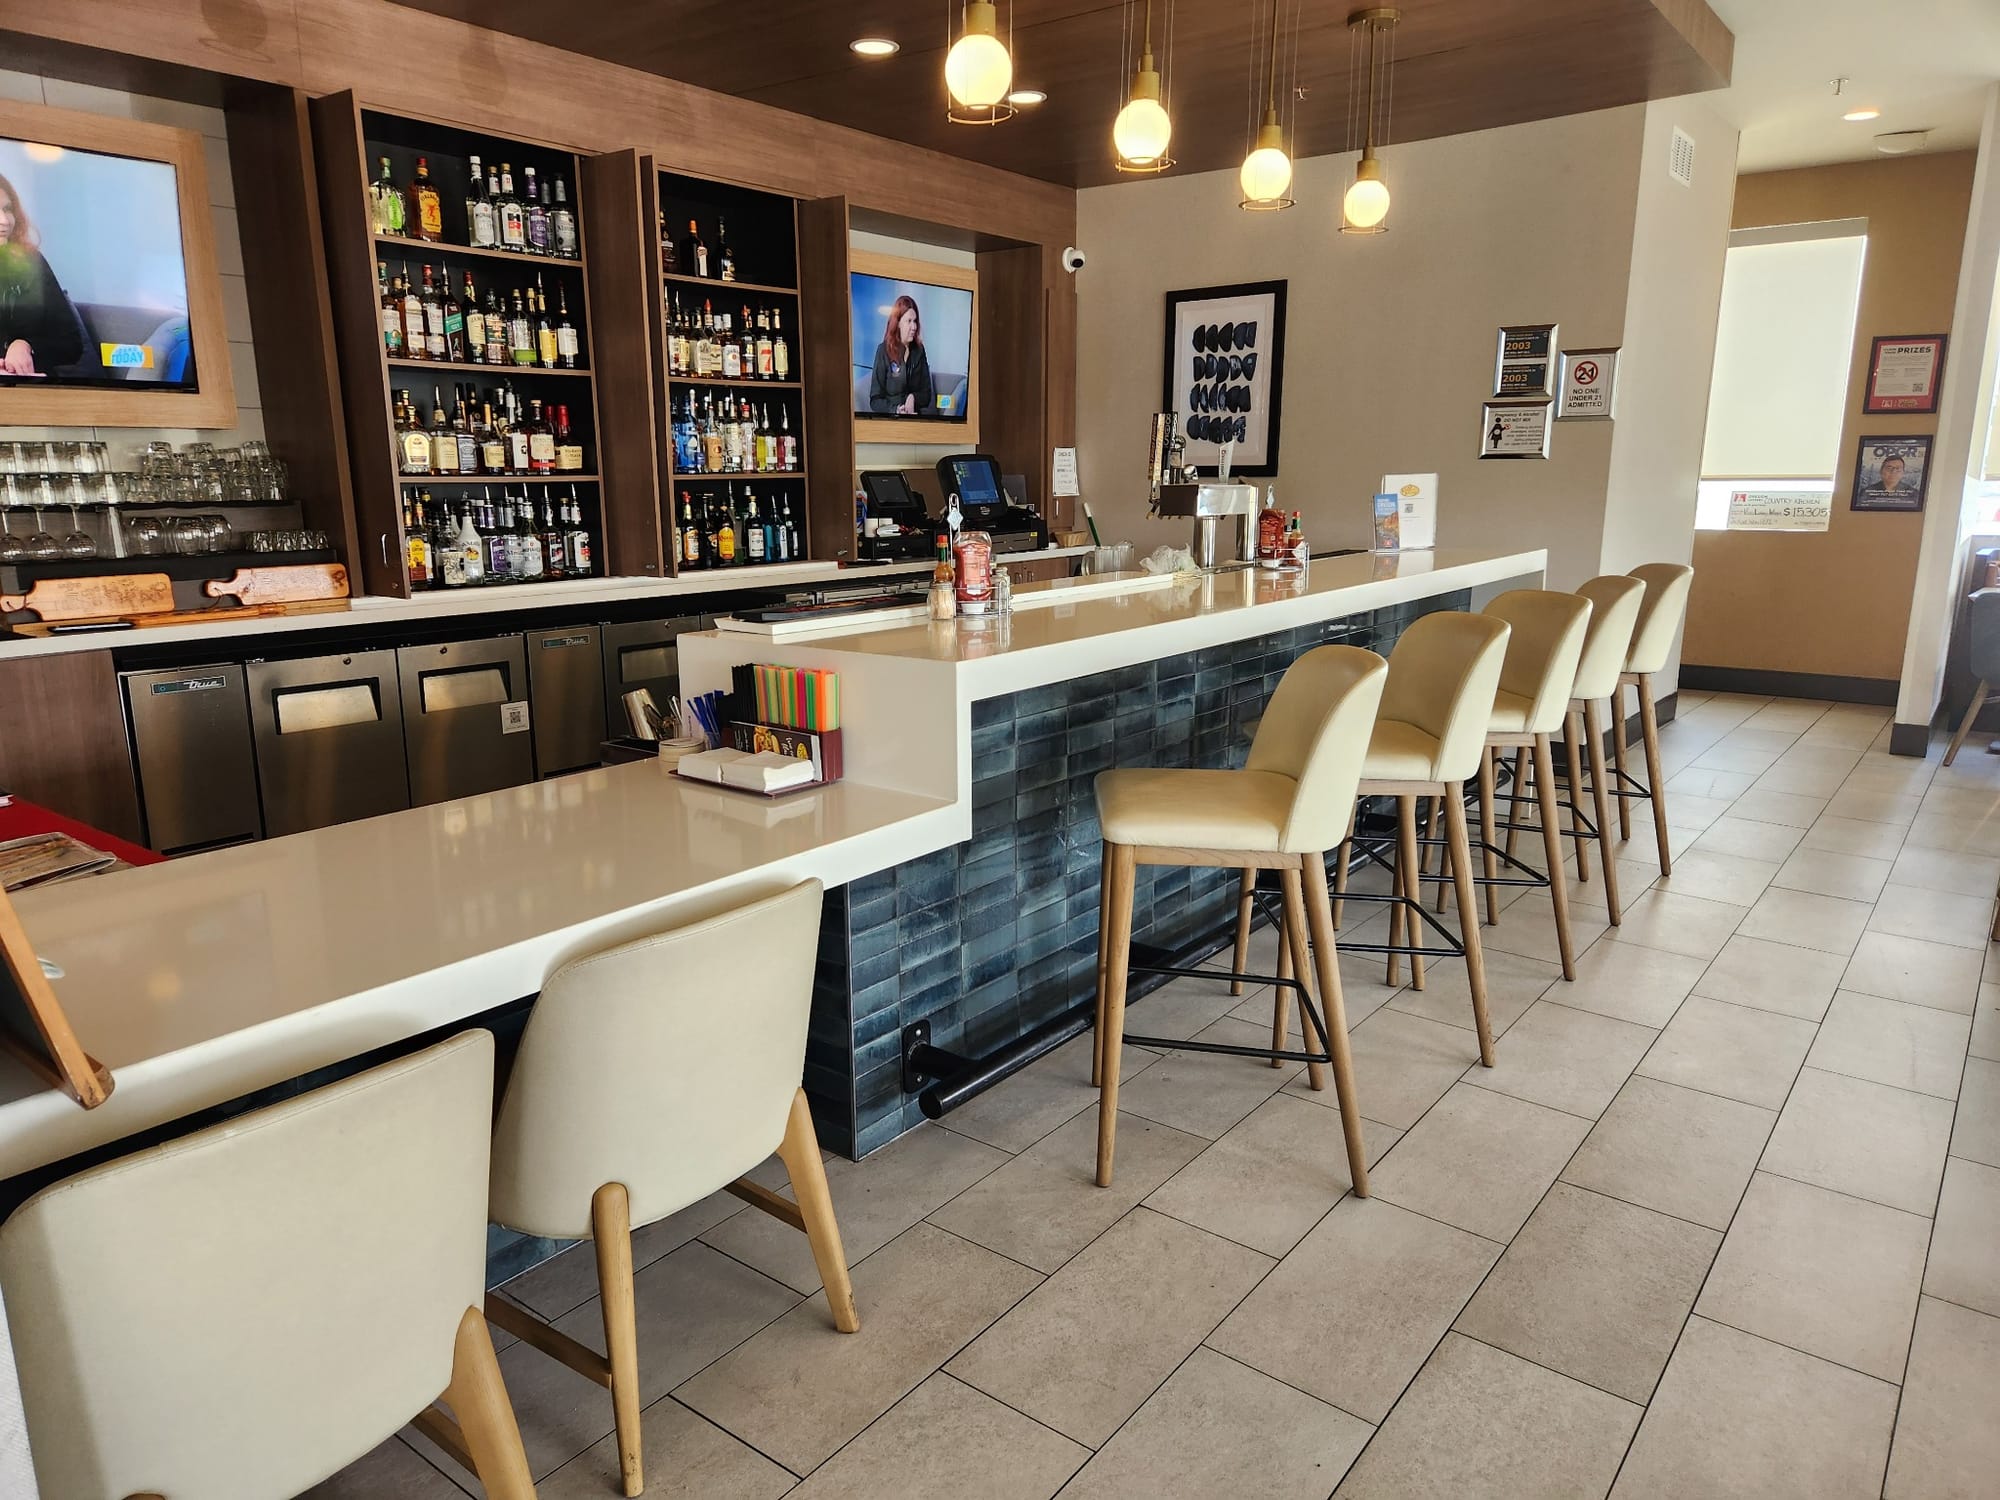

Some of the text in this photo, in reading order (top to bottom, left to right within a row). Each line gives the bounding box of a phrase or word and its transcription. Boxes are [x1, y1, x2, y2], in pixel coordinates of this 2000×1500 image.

[1506, 341, 1531, 350] 2003
[1897, 346, 1932, 354] PRIZES
[761, 348, 772, 372] 7
[1577, 367, 1595, 380] 21
[1503, 374, 1528, 383] 2003
[183, 680, 220, 689] True
